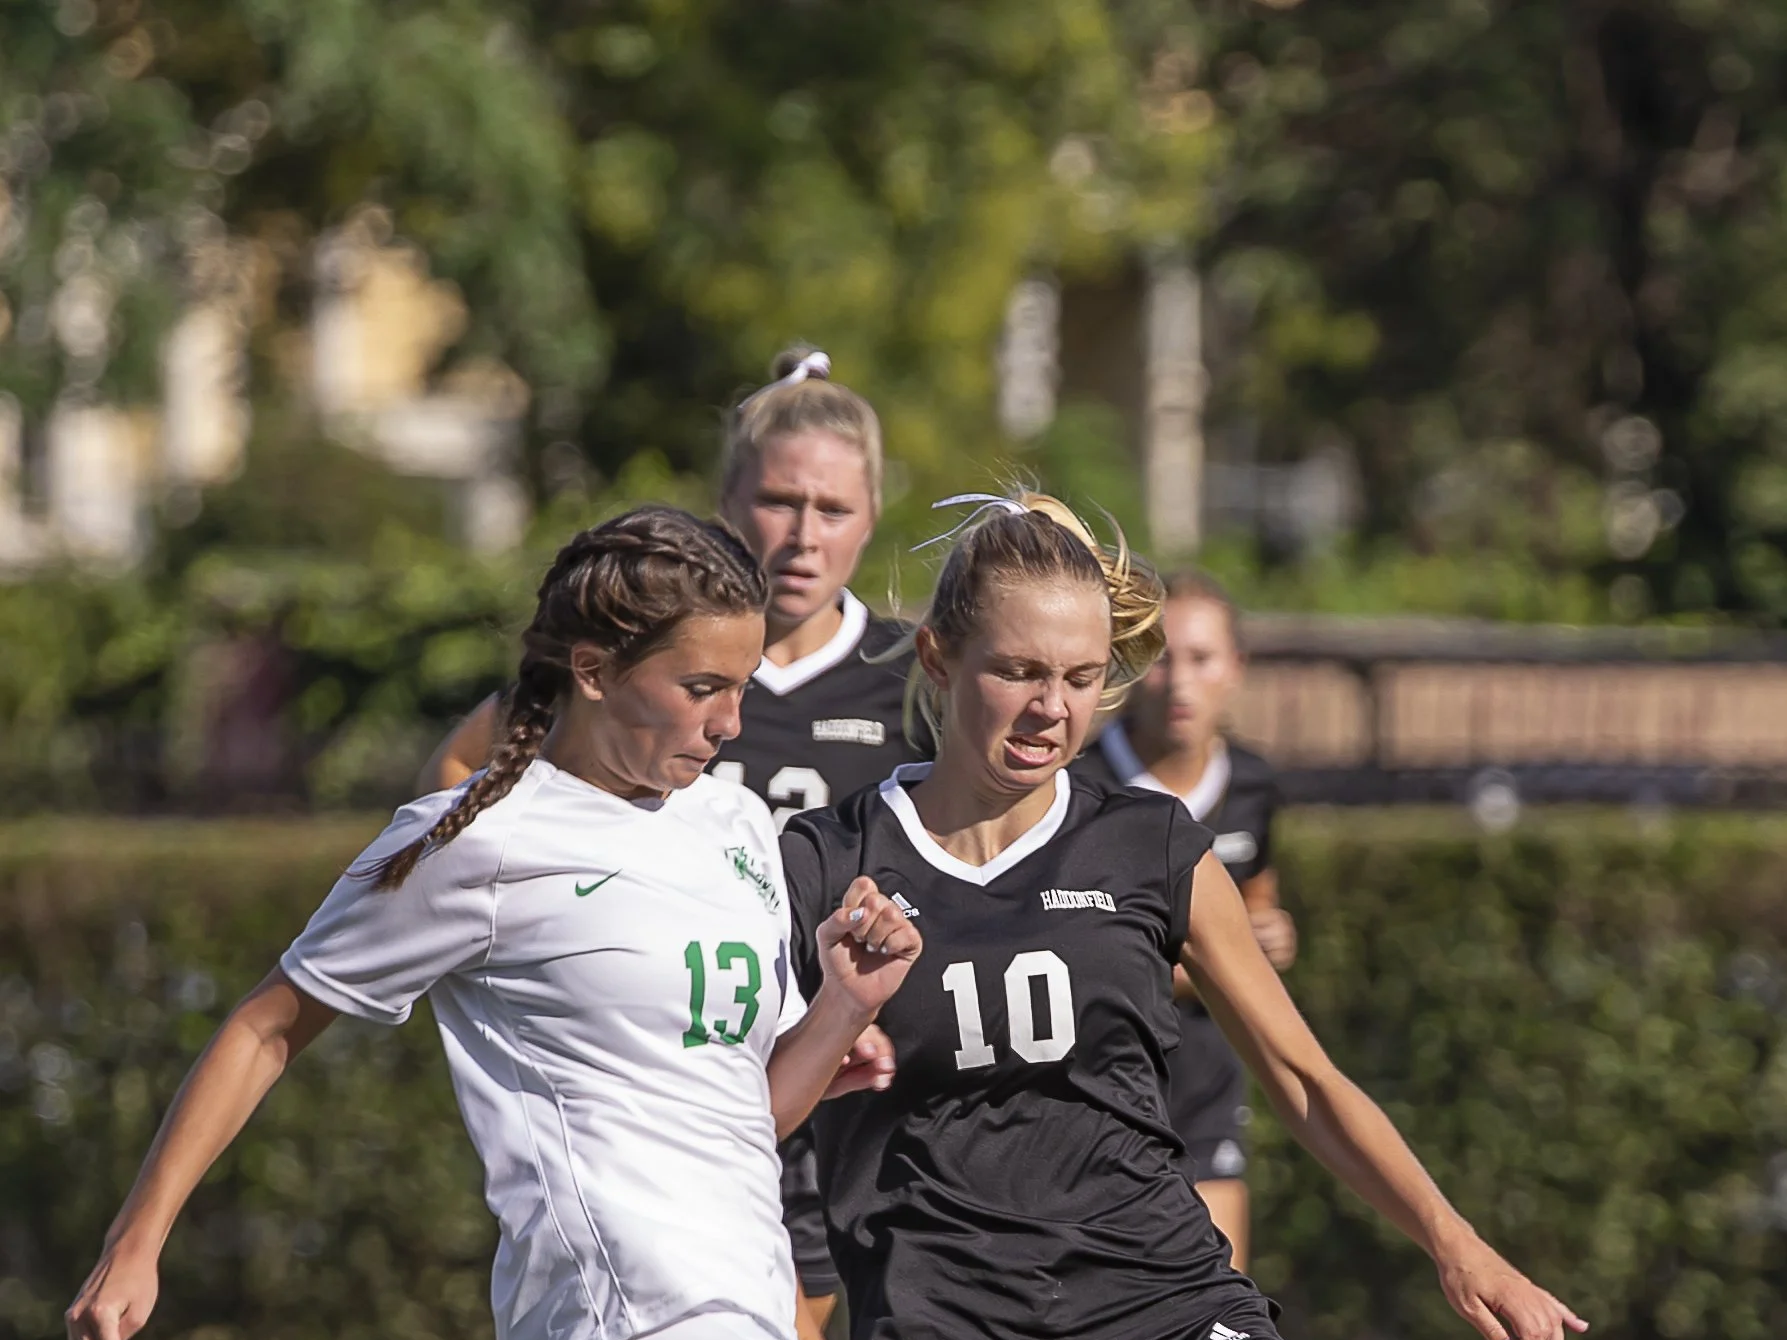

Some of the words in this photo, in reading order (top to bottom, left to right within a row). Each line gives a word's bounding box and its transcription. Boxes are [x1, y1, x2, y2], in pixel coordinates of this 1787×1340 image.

[1040, 889, 1117, 912] HADDONFIELD
[682, 941, 762, 1049] 13
[942, 950, 1076, 1070] 10
